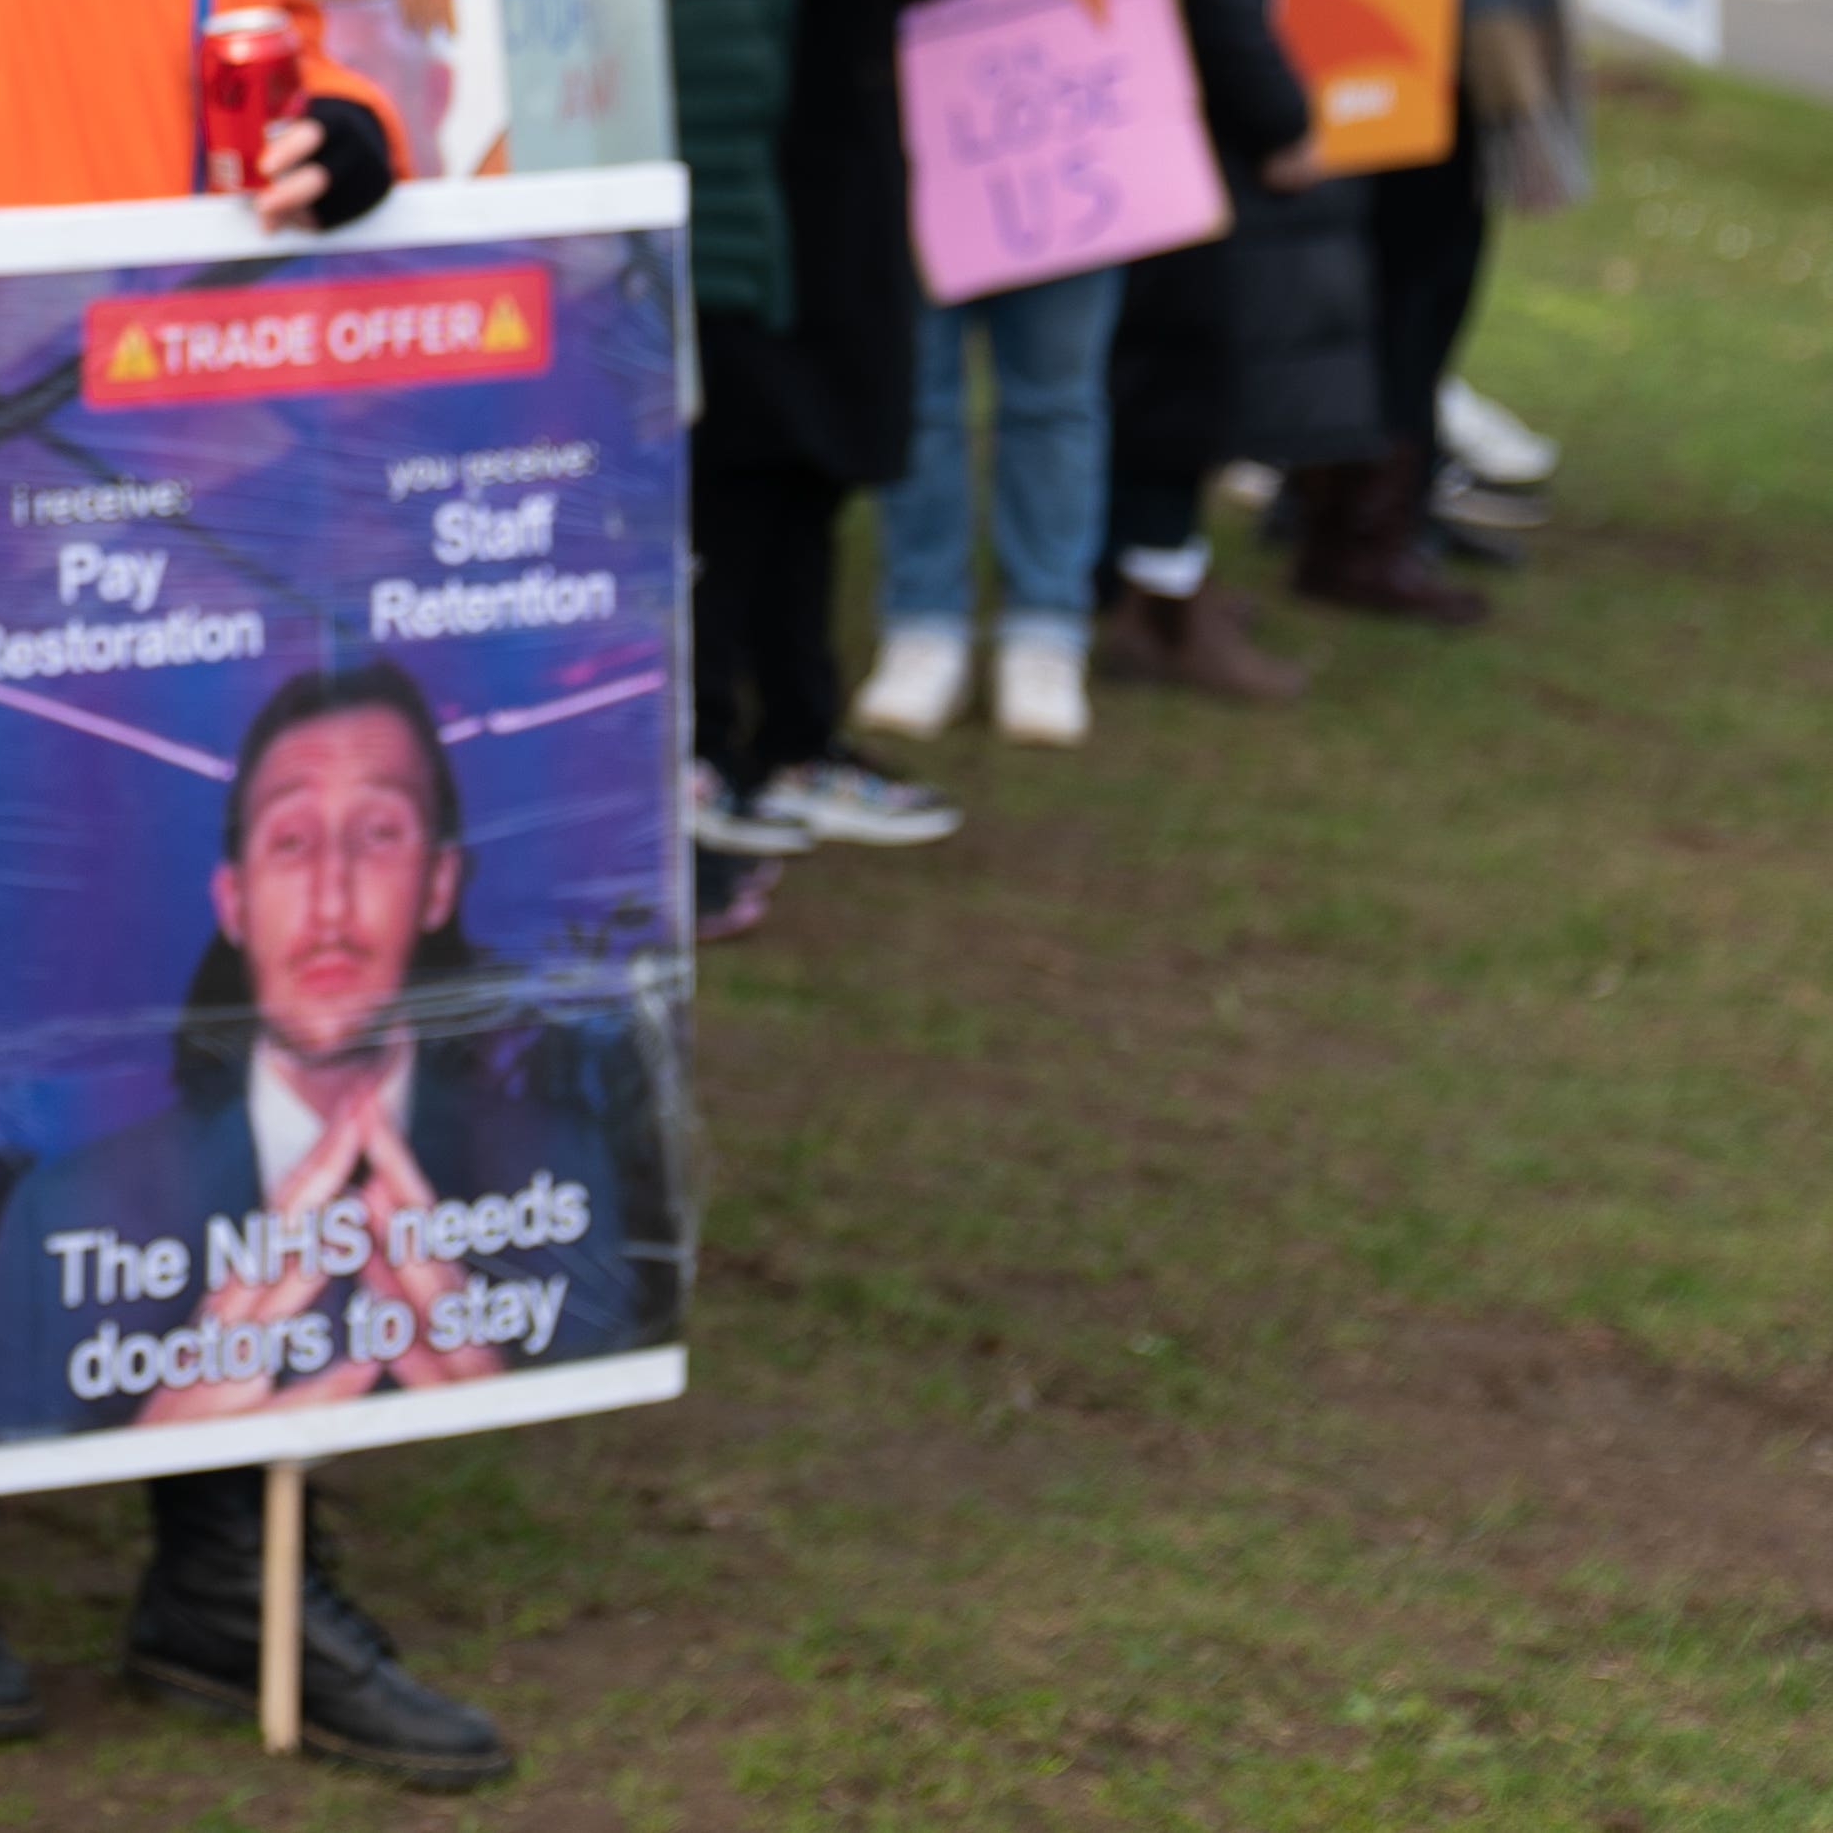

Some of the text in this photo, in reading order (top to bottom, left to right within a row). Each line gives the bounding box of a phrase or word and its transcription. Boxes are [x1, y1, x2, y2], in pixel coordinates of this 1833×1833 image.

[983, 148, 1126, 262] US
[157, 304, 484, 373] TRADE OFFER
[387, 453, 457, 503] you
[433, 493, 558, 566] Staff
[57, 542, 169, 612] Pay
[371, 567, 615, 642] Retention
[46, 1168, 590, 1308] The NHS needs
[68, 1271, 568, 1401] doctors to stay
